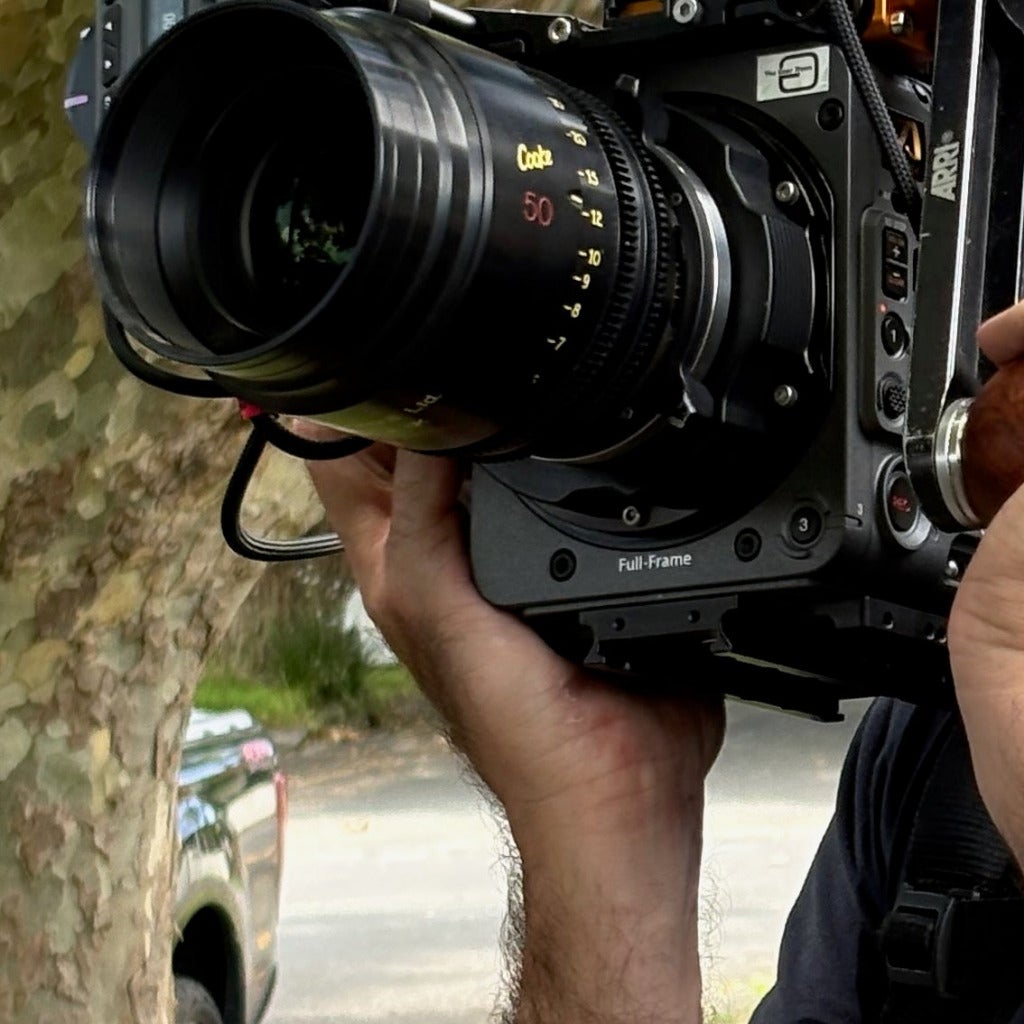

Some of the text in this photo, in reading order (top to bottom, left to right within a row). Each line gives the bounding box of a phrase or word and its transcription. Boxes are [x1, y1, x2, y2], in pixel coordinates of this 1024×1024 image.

[516, 143, 554, 171] Cooke
[930, 140, 960, 202] ARRI
[523, 190, 554, 226] 50
[590, 209, 604, 228] 12
[588, 248, 602, 267] 10
[798, 517, 809, 532] 3
[618, 553, 693, 573] Full-Frame
